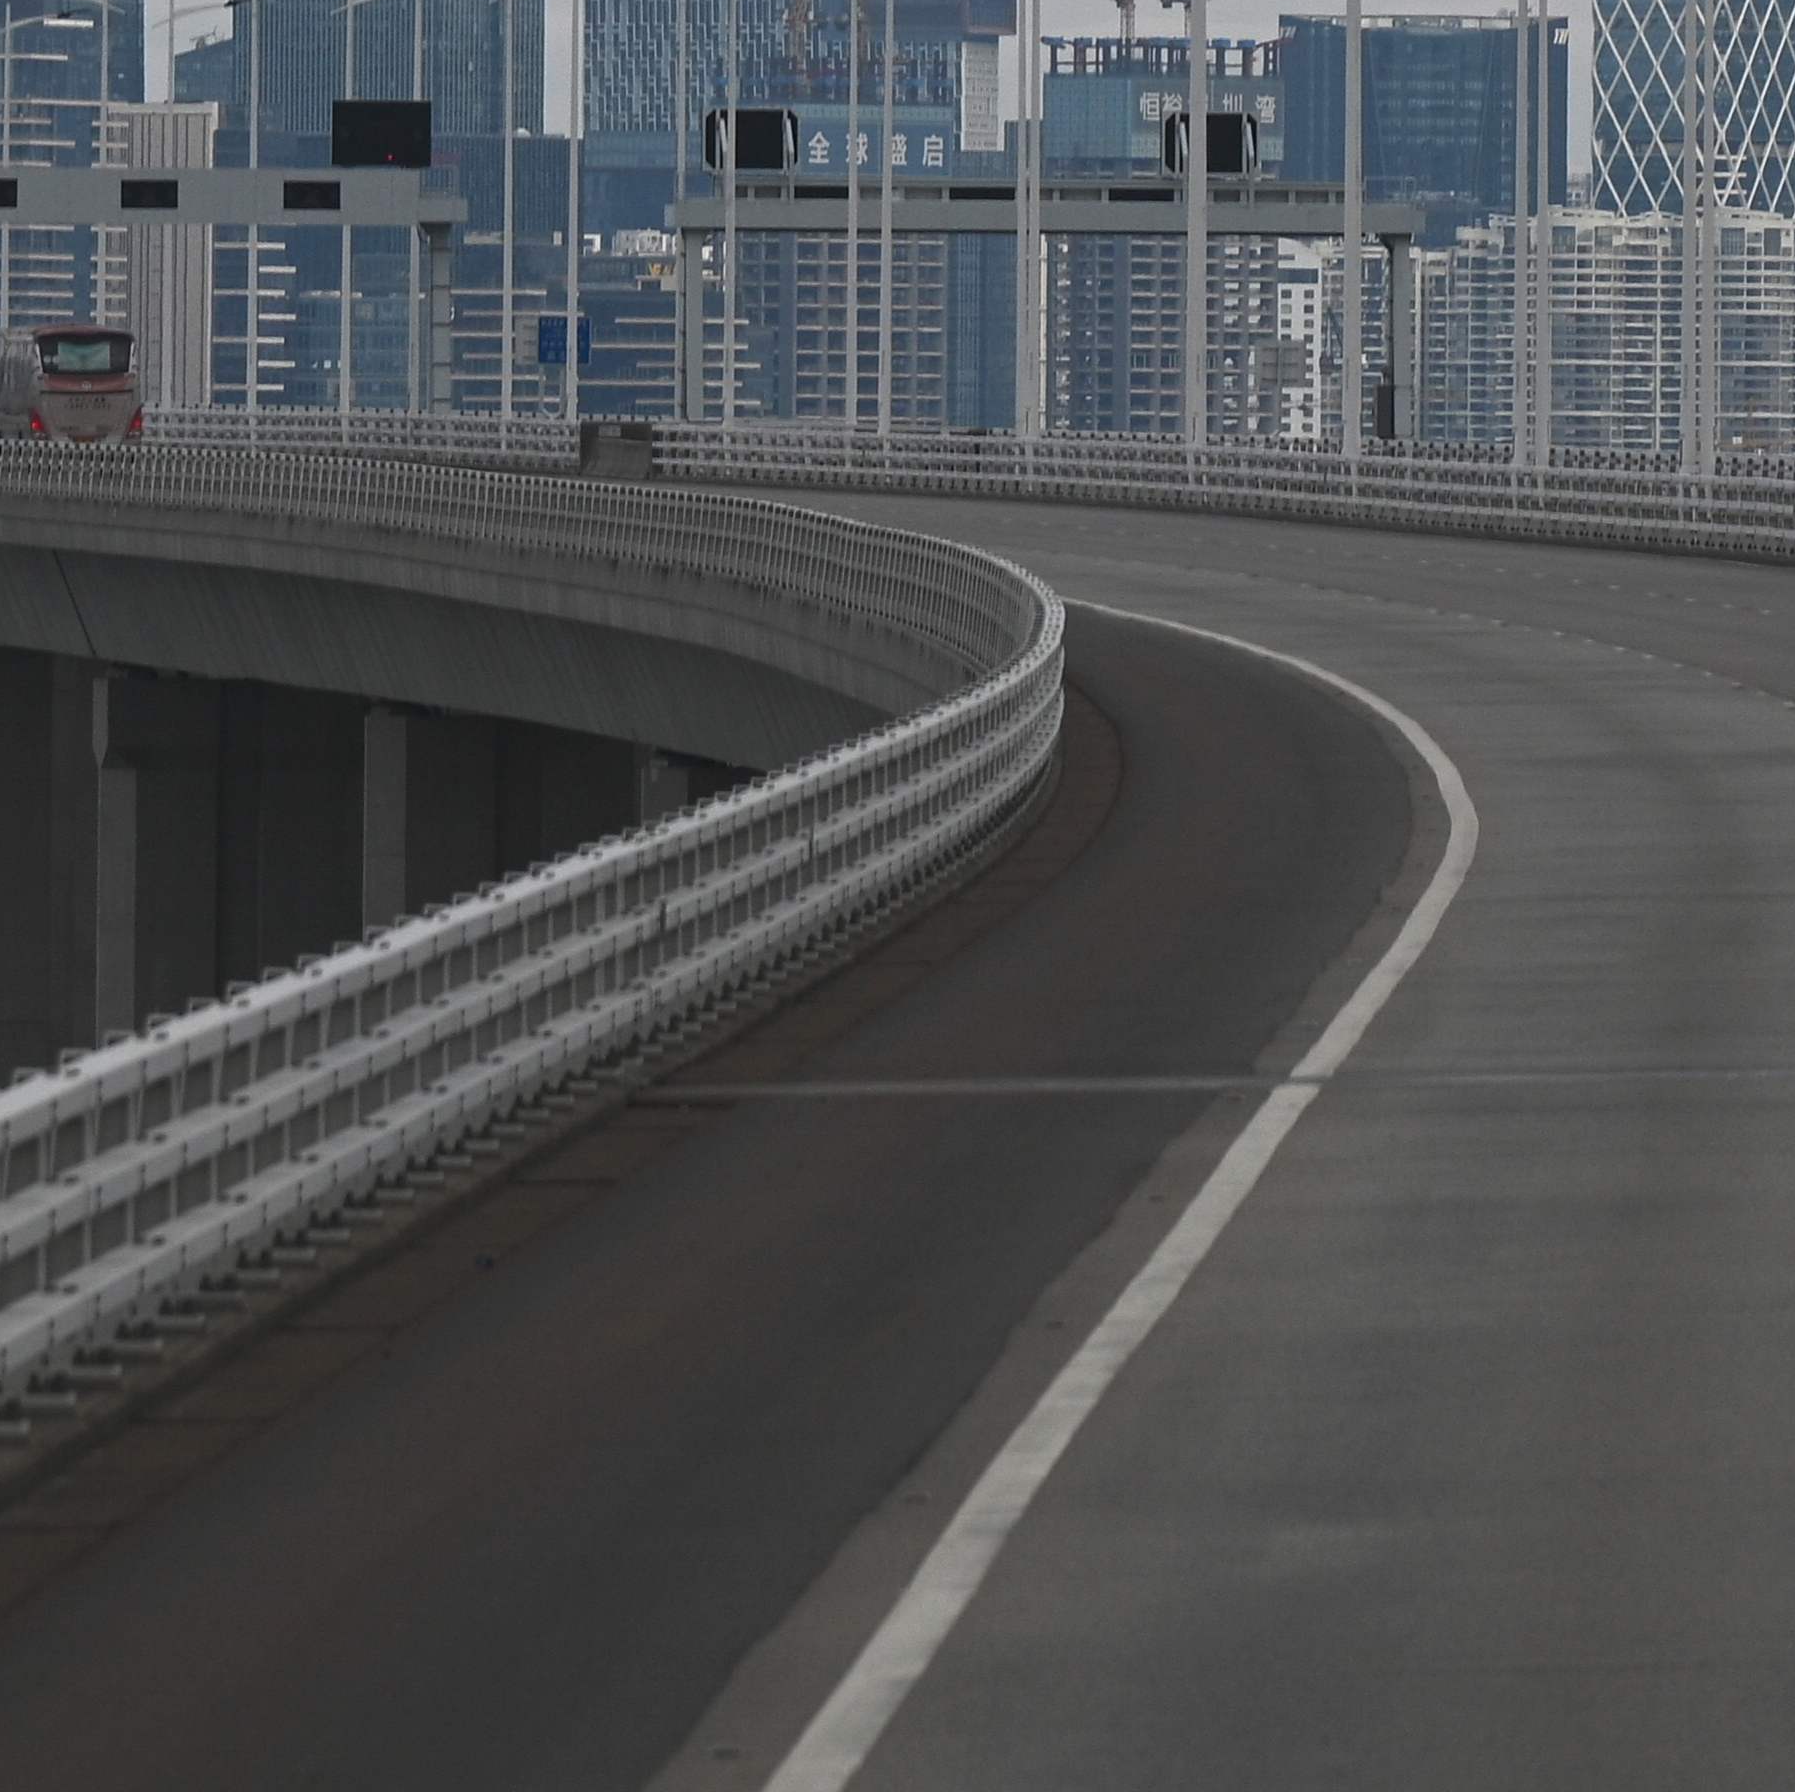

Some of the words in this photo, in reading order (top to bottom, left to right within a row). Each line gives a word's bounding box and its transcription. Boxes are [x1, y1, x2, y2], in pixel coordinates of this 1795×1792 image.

[1140, 92, 1276, 123] 恒裕圳湾
[808, 131, 944, 167] 全球盛启
